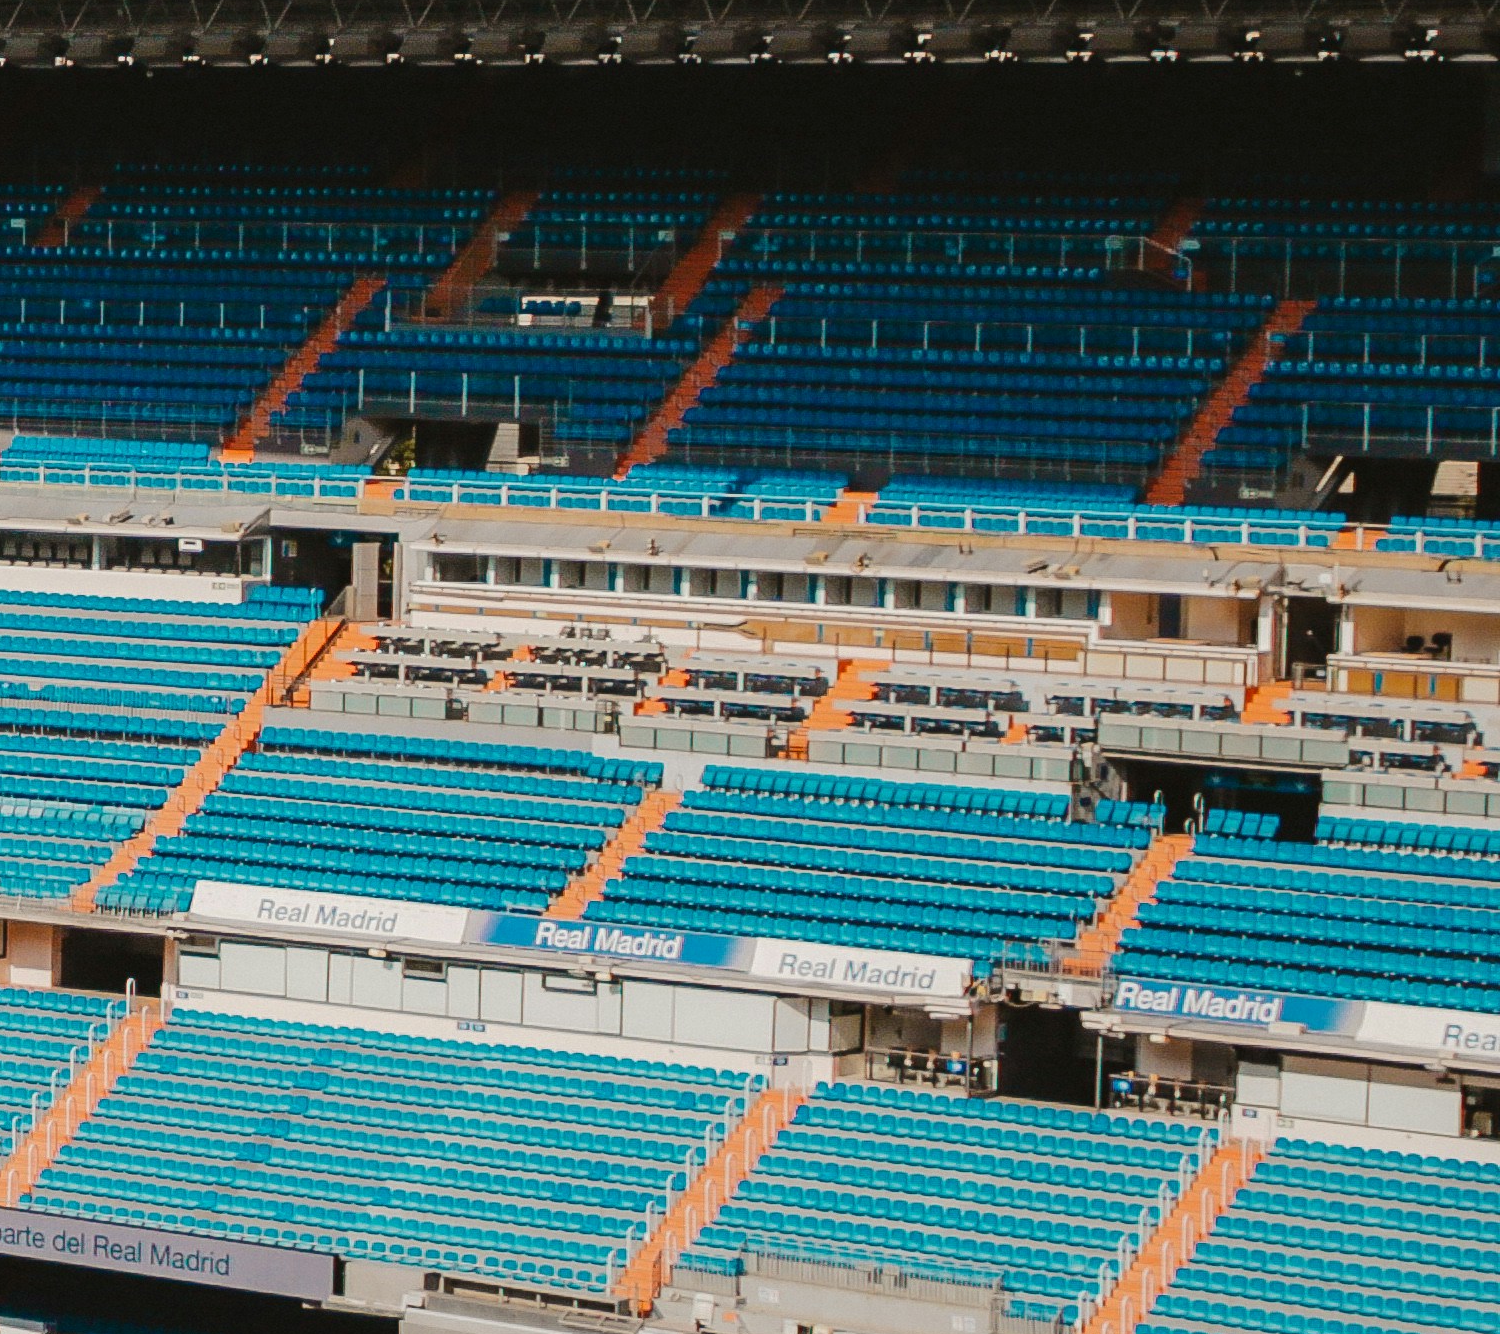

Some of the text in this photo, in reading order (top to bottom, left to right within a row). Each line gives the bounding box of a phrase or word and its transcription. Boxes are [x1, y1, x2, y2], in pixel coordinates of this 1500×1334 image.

[257, 899, 397, 932] Real Madrid
[535, 922, 682, 958] Real Madrid
[779, 953, 936, 988] Real Madrid
[1115, 981, 1281, 1023] Real Madrid
[1443, 1023, 1499, 1051] Rea
[52, 1229, 85, 1254] del
[93, 1236, 142, 1264] Real
[150, 1243, 230, 1277] Madrid
